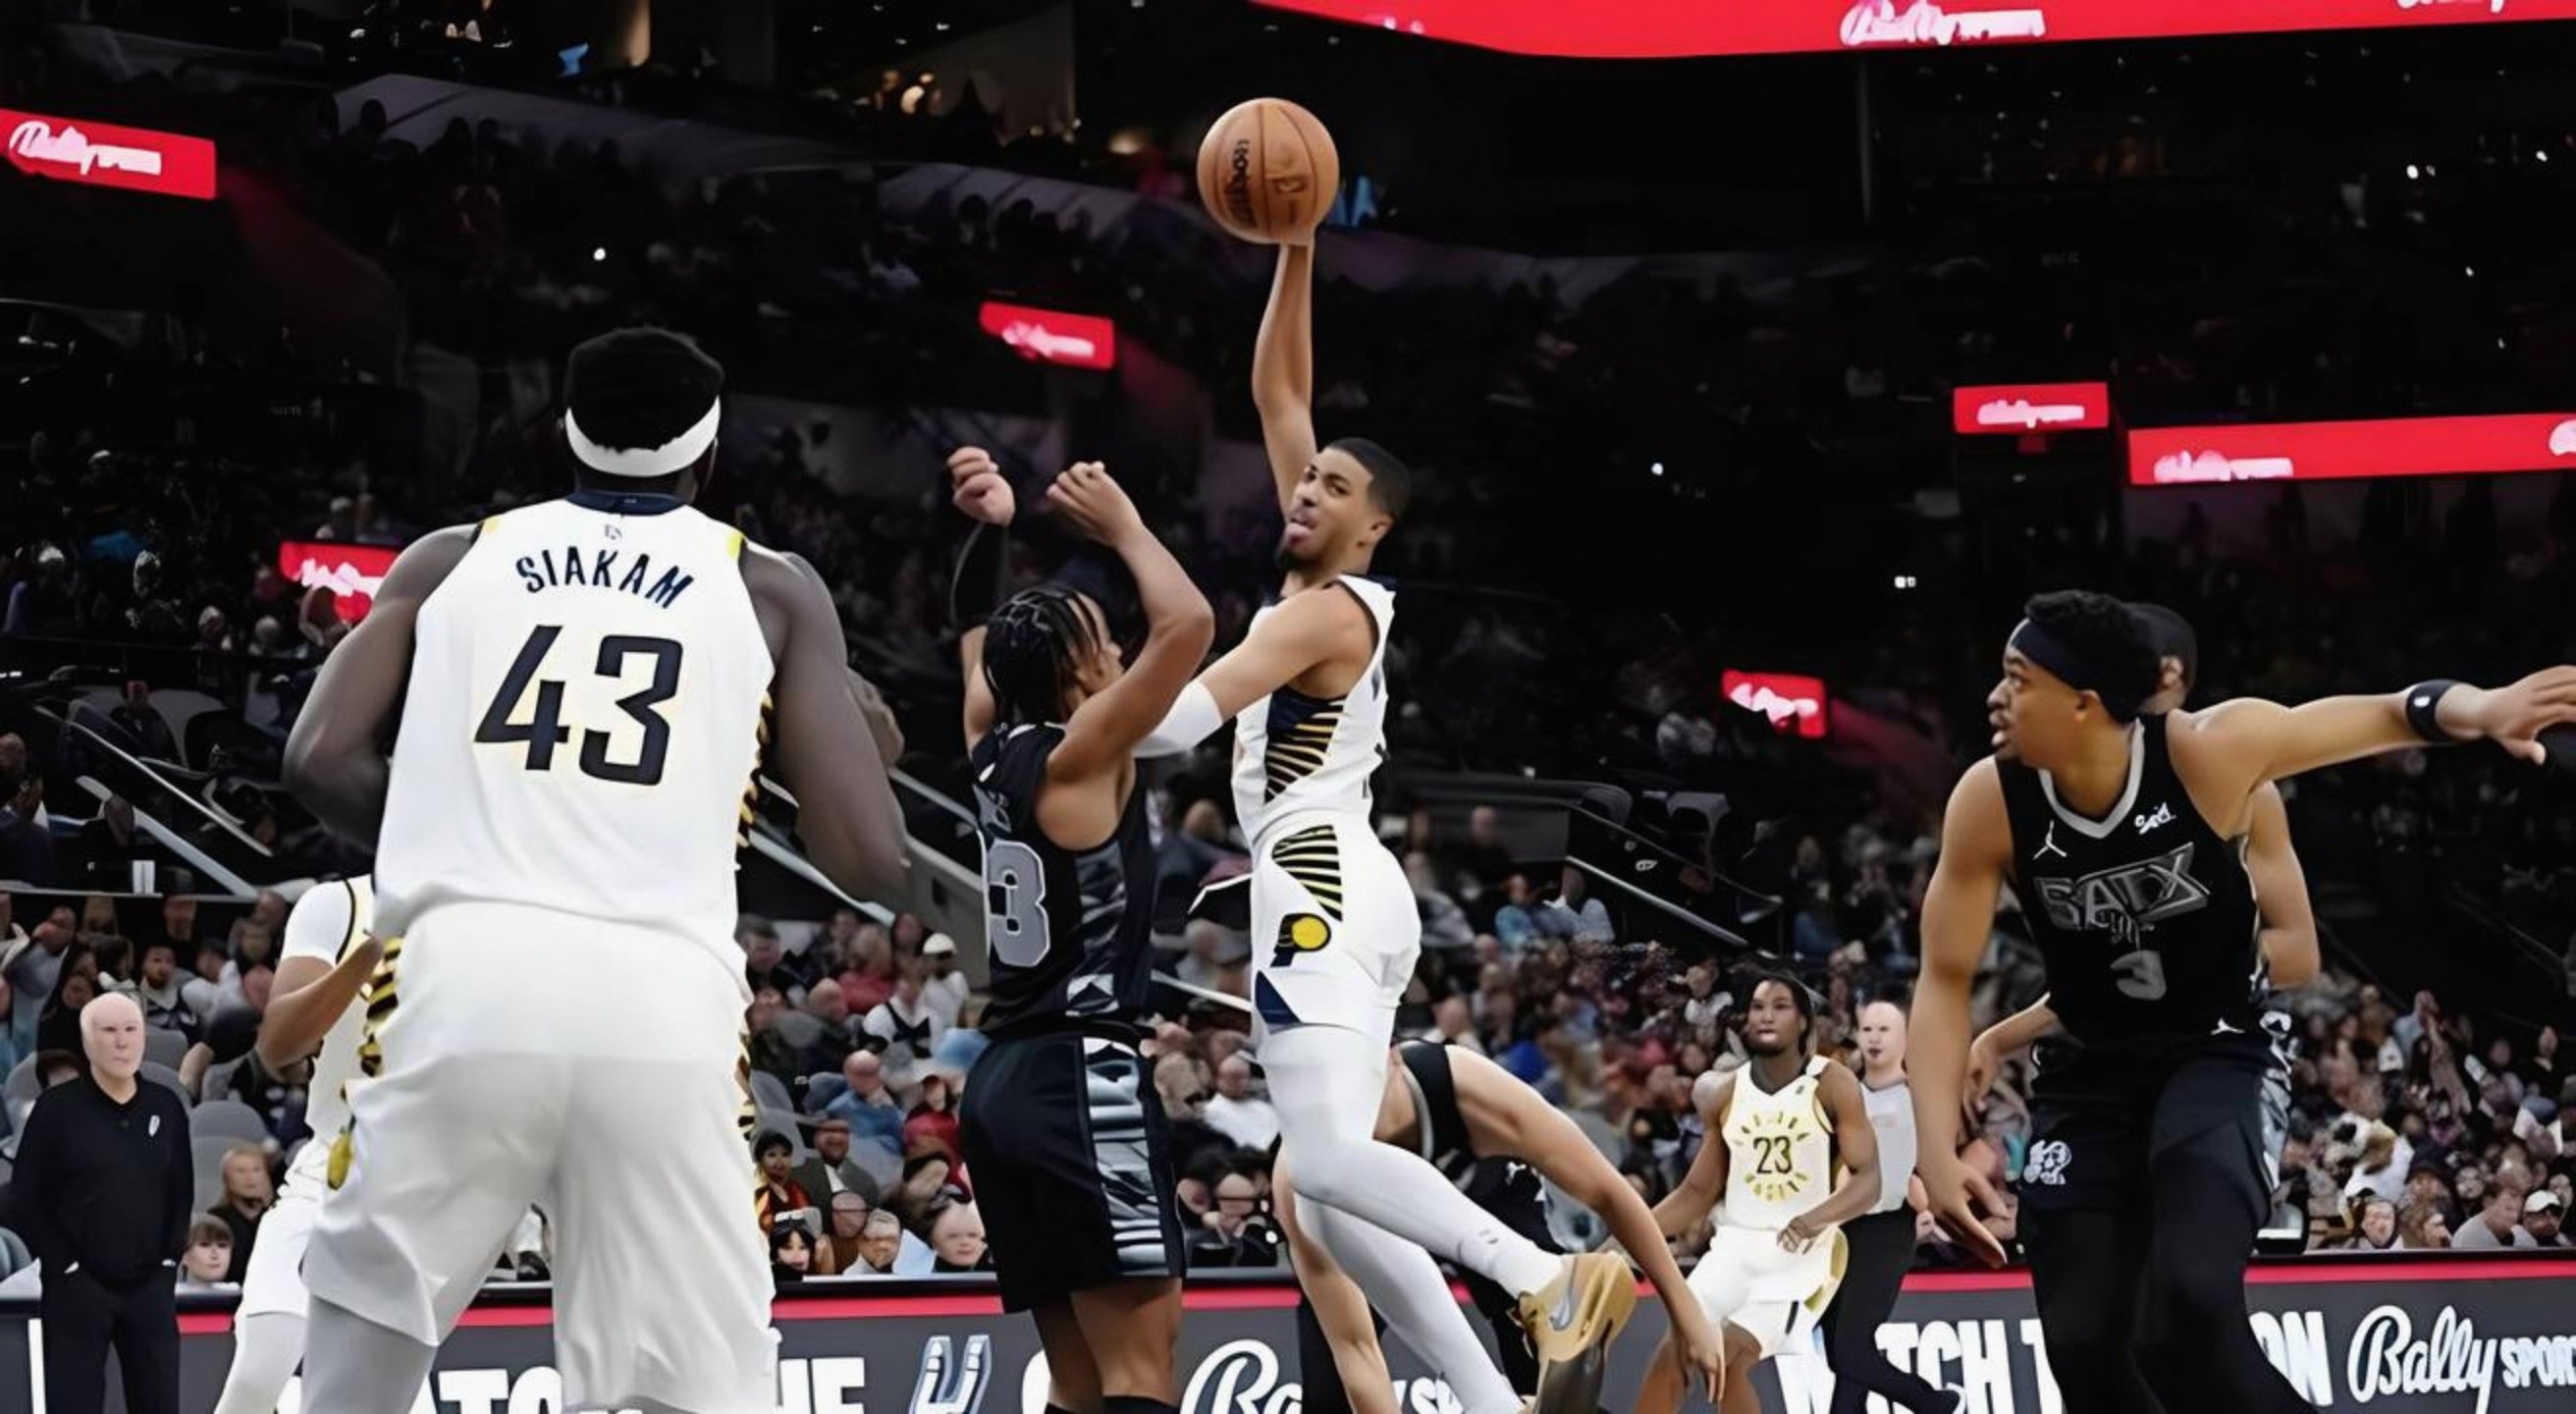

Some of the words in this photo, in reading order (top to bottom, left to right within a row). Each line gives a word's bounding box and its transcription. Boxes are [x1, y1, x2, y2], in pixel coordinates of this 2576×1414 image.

[515, 546, 694, 609] SIAKAM
[474, 625, 683, 786] 43
[1753, 1136, 1792, 1174] 23
[2347, 1305, 2497, 1414] Bally
[2499, 1335, 2576, 1388] SPOR
